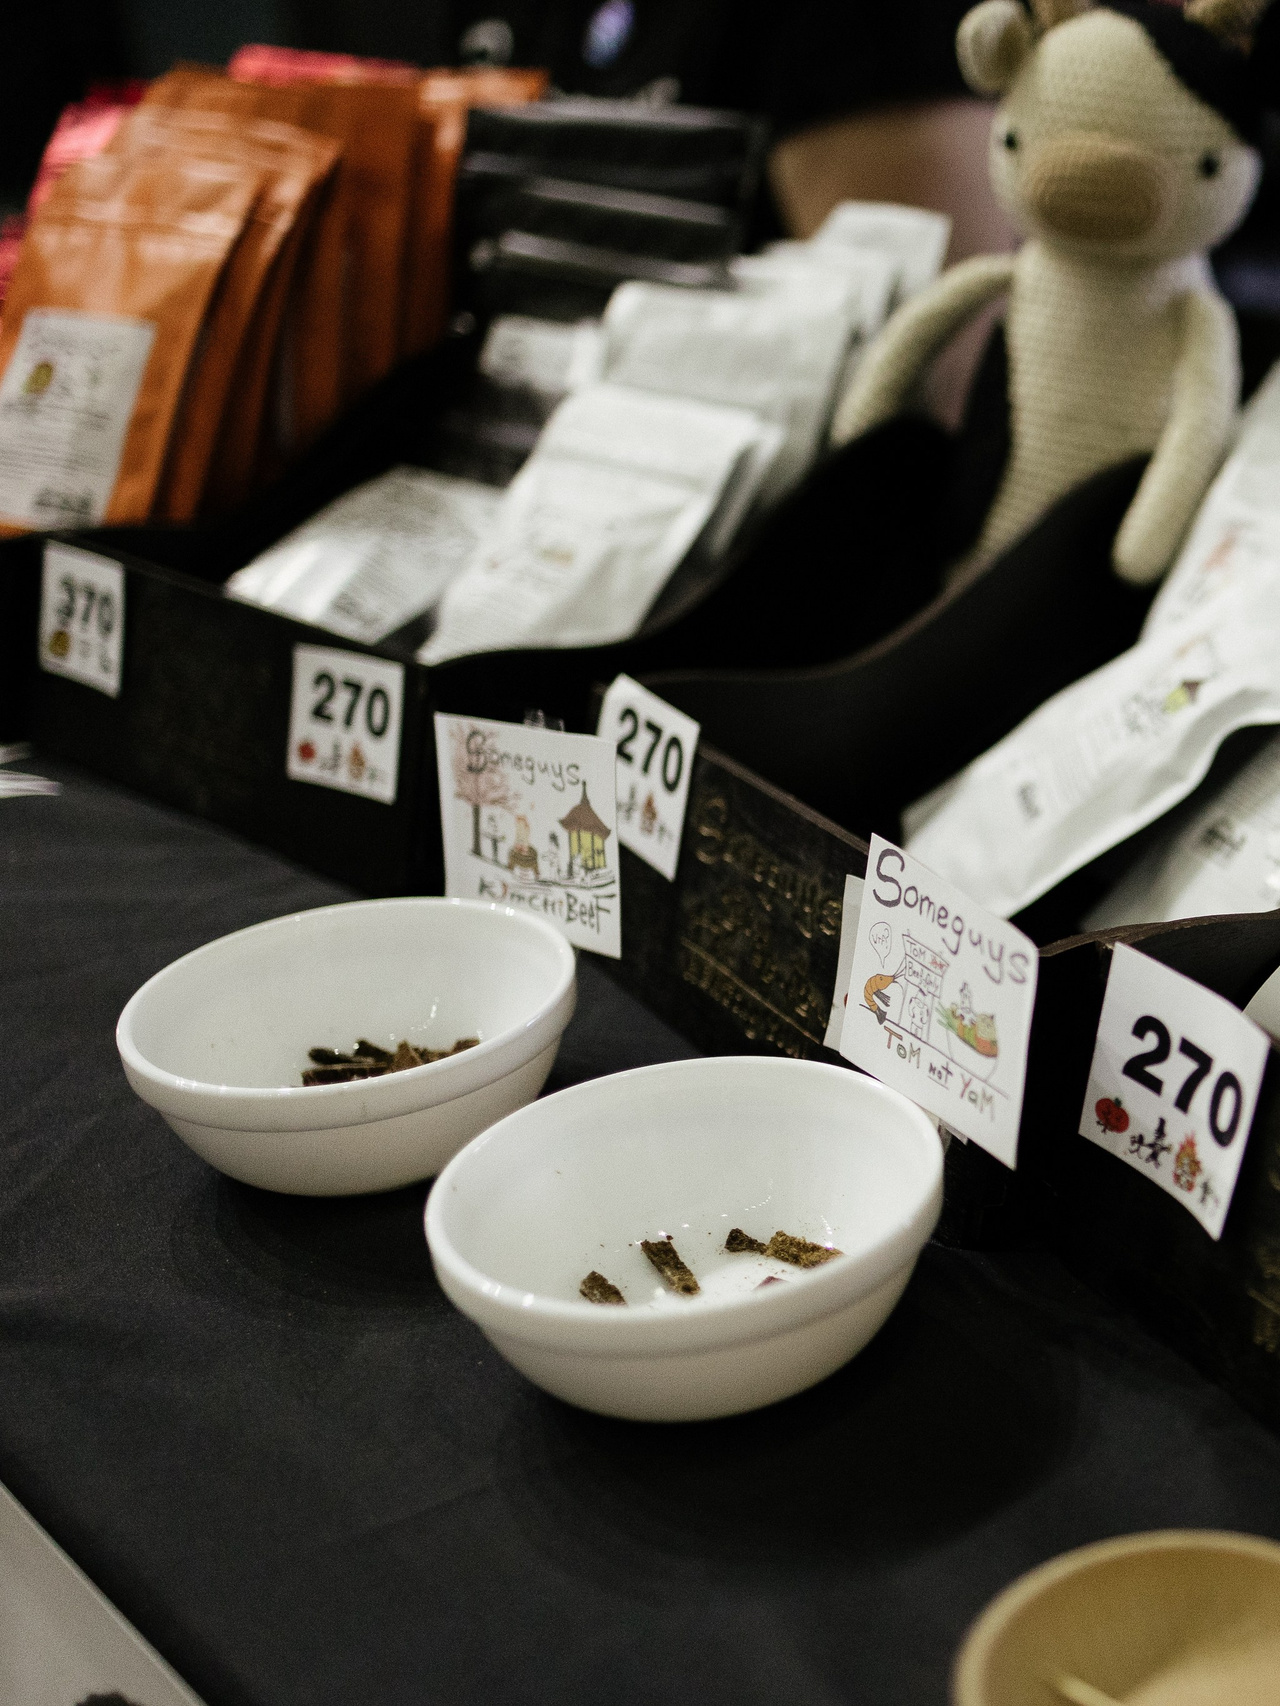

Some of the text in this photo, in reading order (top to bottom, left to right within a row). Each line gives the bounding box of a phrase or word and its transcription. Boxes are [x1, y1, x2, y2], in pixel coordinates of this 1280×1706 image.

[311, 672, 391, 737] 270
[466, 730, 581, 791] Someguys
[616, 707, 684, 793] 270
[872, 847, 1030, 985] Someguys
[1122, 1015, 1243, 1148] 270
